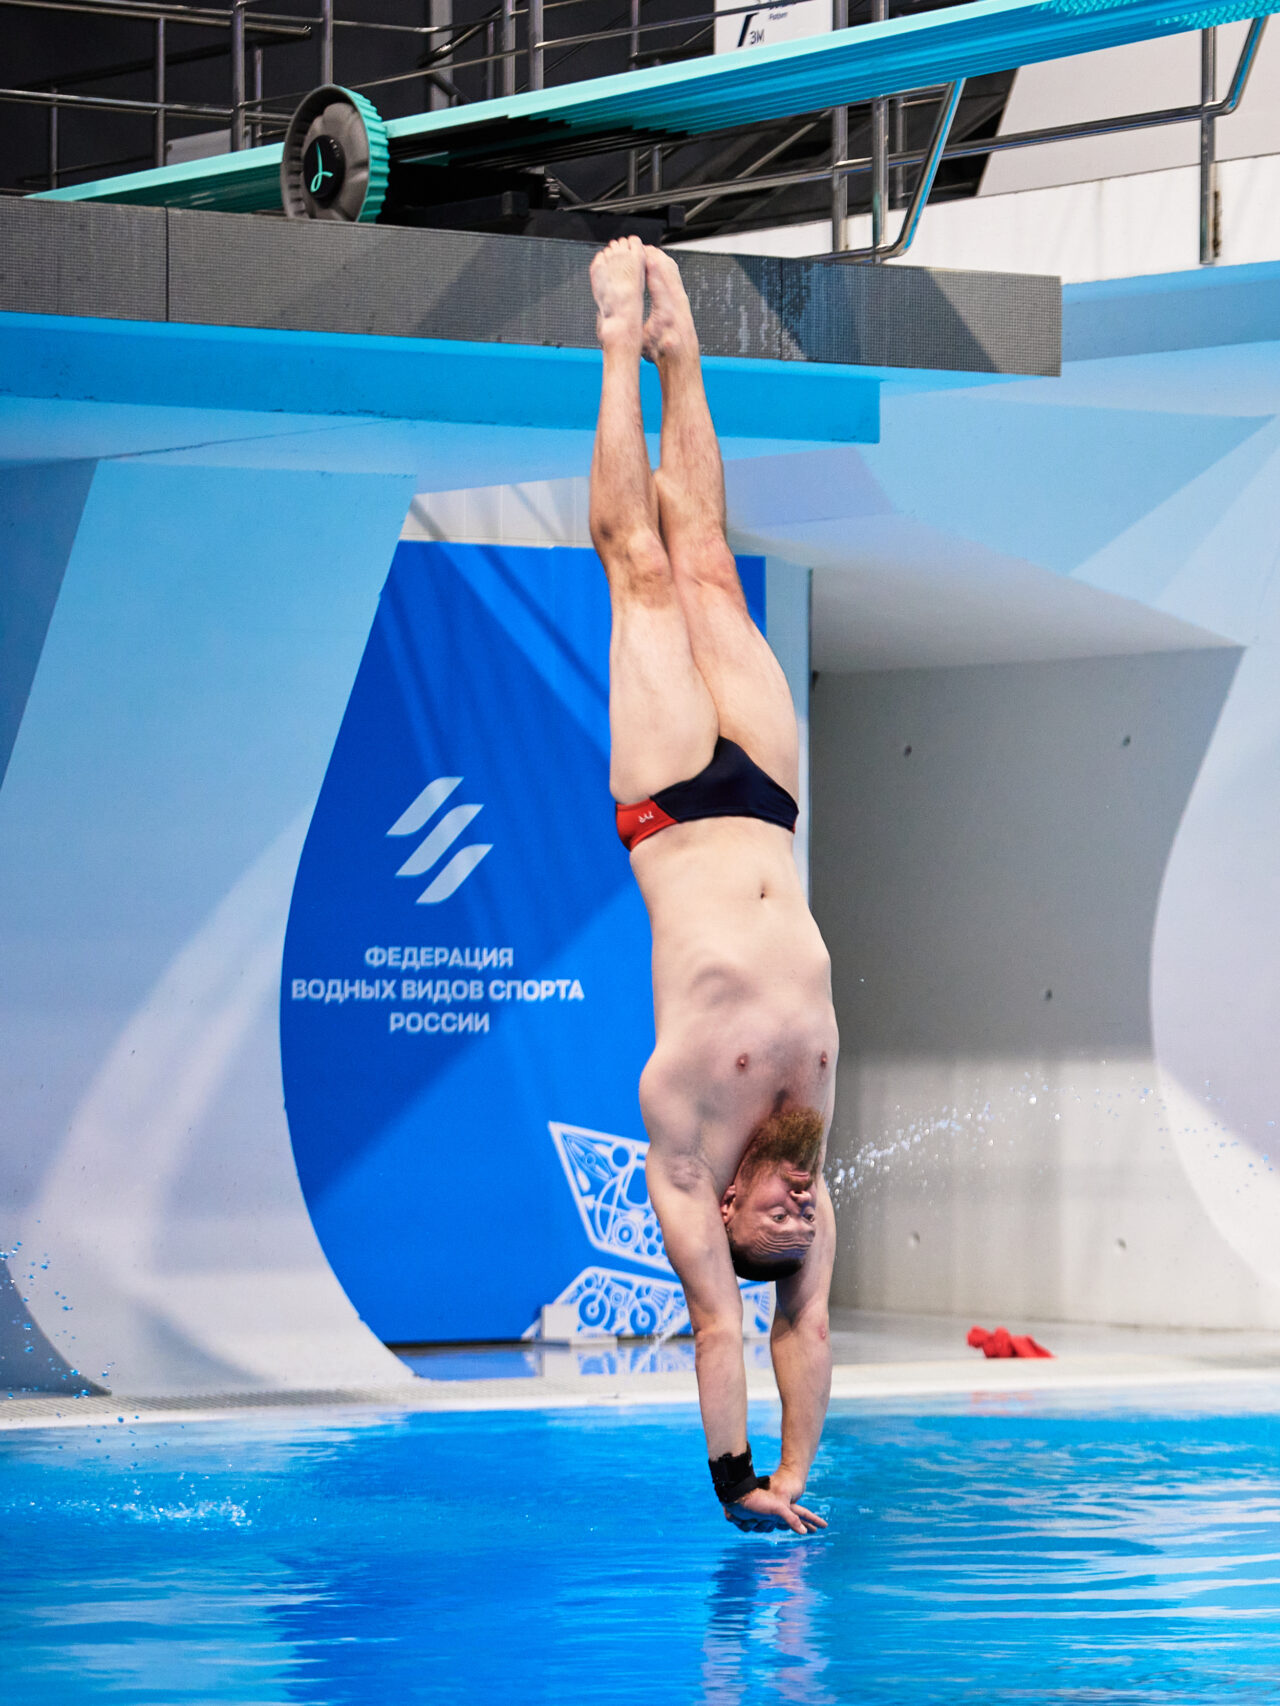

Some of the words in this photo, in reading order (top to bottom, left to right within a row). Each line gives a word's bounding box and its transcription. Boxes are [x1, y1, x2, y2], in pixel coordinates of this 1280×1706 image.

[364, 946, 513, 970] ФЕДЕРАЦИЯ
[292, 979, 396, 1003] ВОДНЫХ
[401, 979, 484, 1003] ВИДОВ
[489, 979, 585, 1001] СПОРТА
[390, 1012, 489, 1032] РОССИИ
